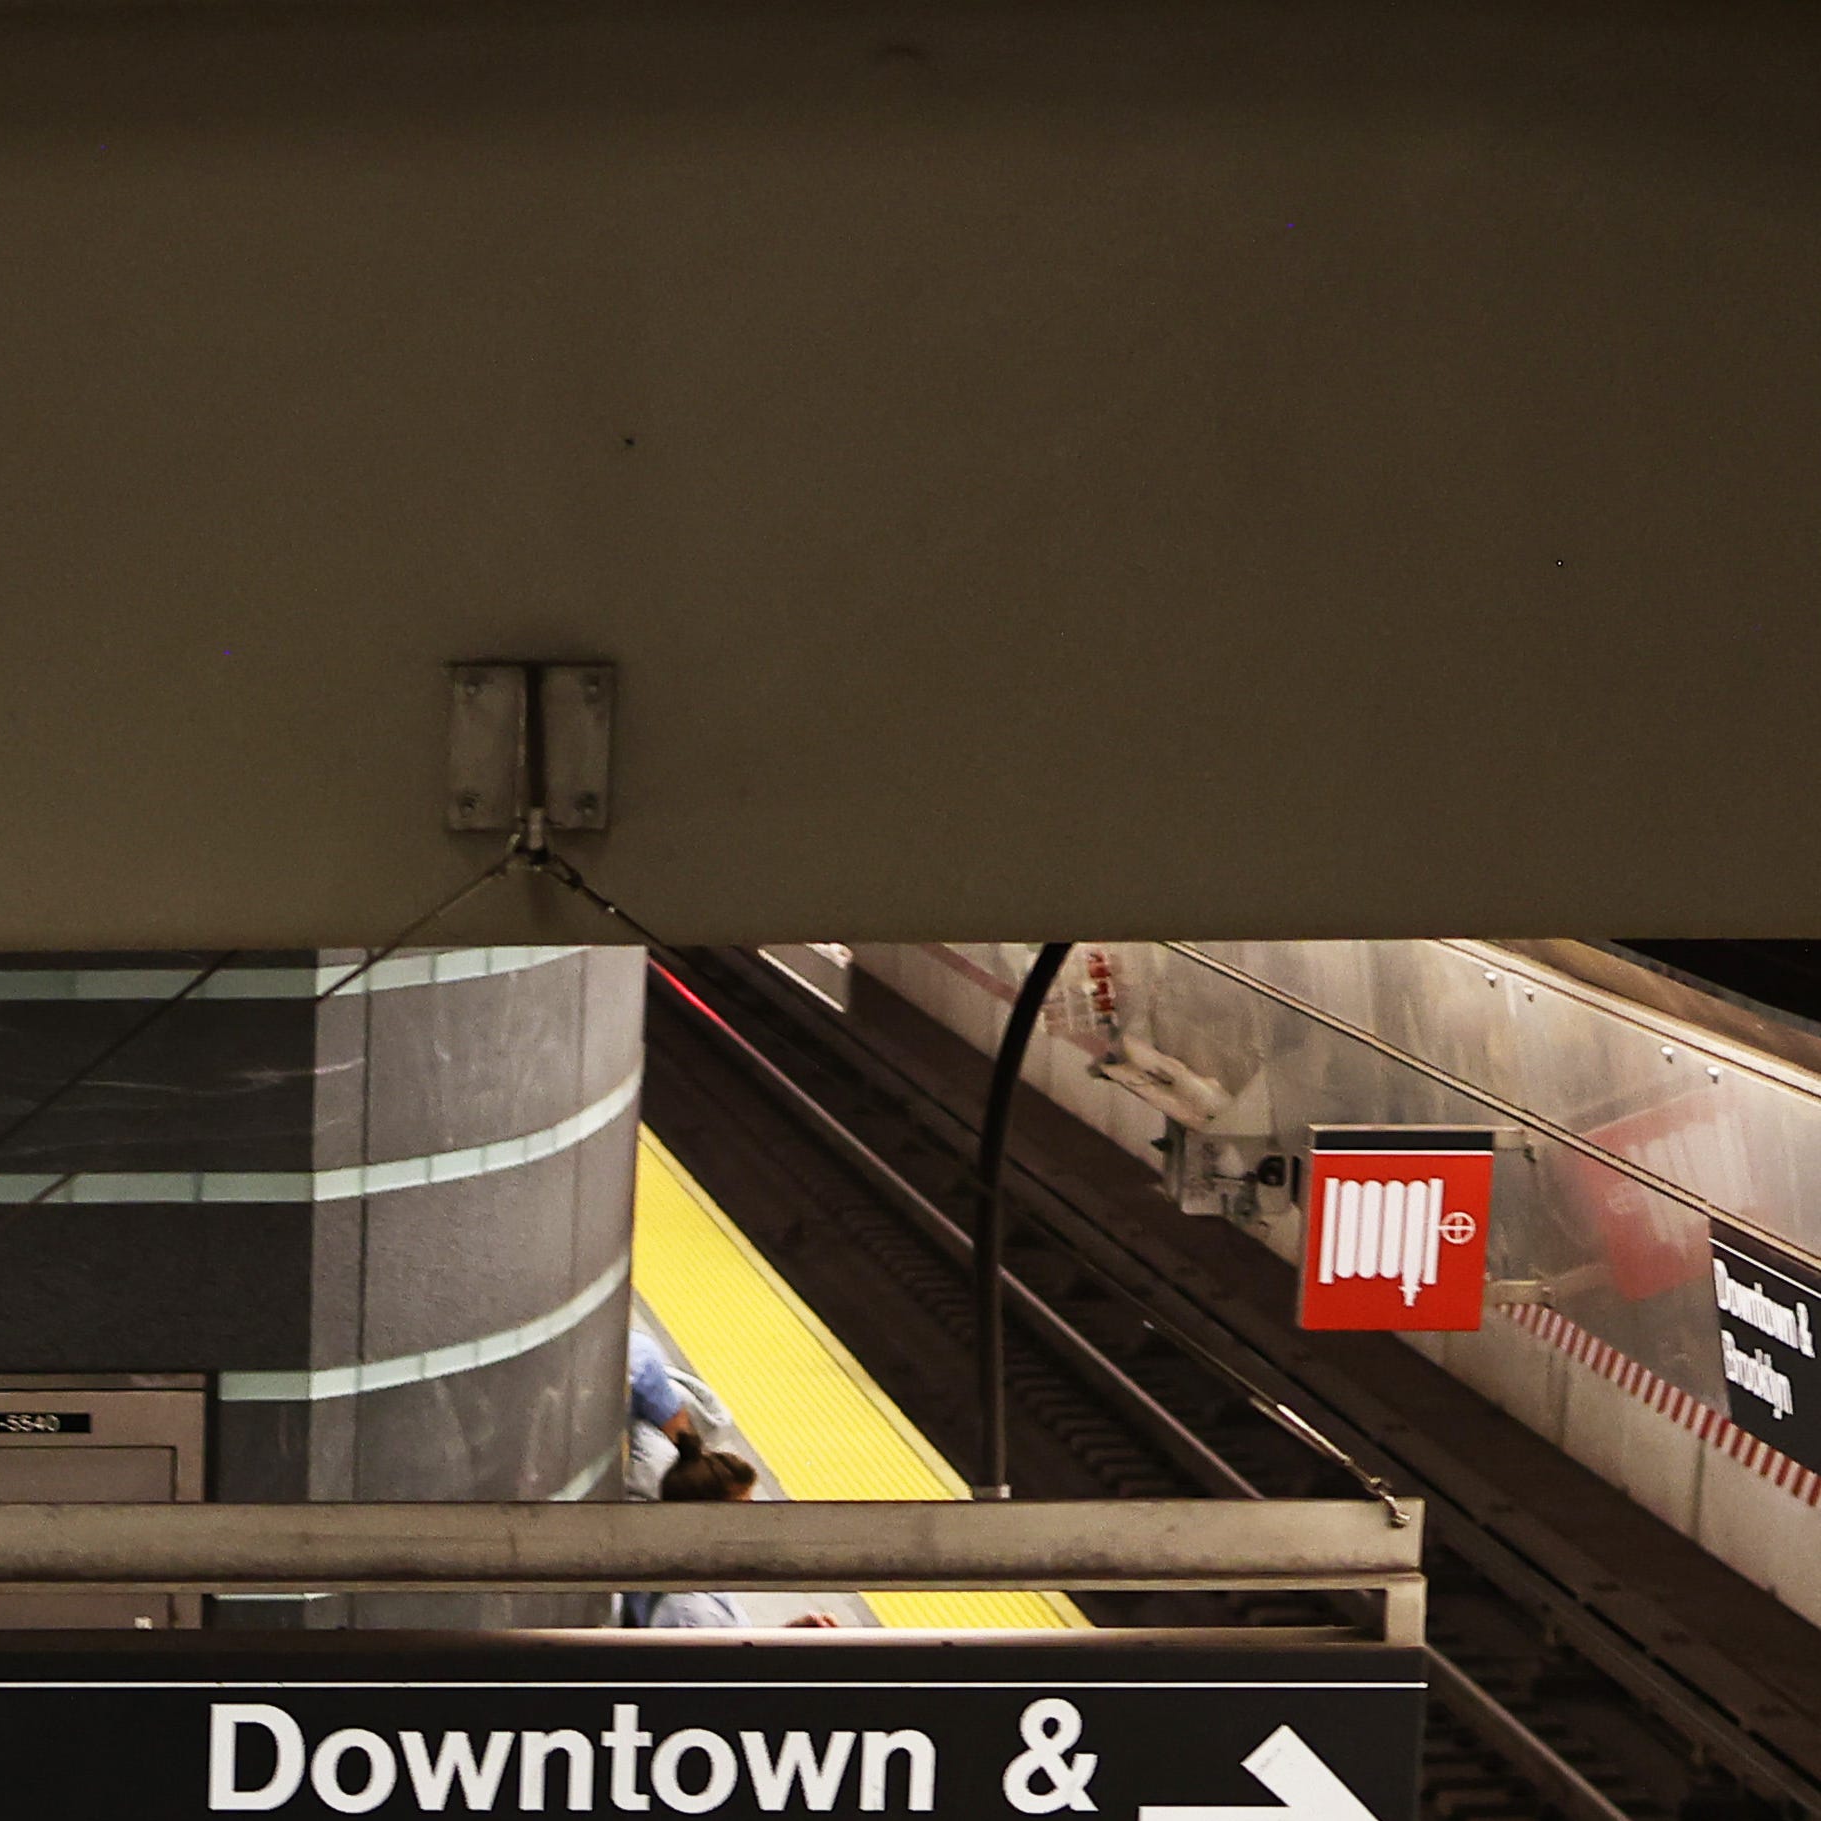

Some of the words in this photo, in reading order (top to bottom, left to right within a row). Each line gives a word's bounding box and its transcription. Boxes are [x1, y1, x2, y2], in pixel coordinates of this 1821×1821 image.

[1712, 1258, 1799, 1349] Downtown
[1796, 1302, 1816, 1358] &
[1720, 1329, 1794, 1420] Brooklyn
[209, 1703, 936, 1814] Downtown
[1002, 1698, 1100, 1814] &
